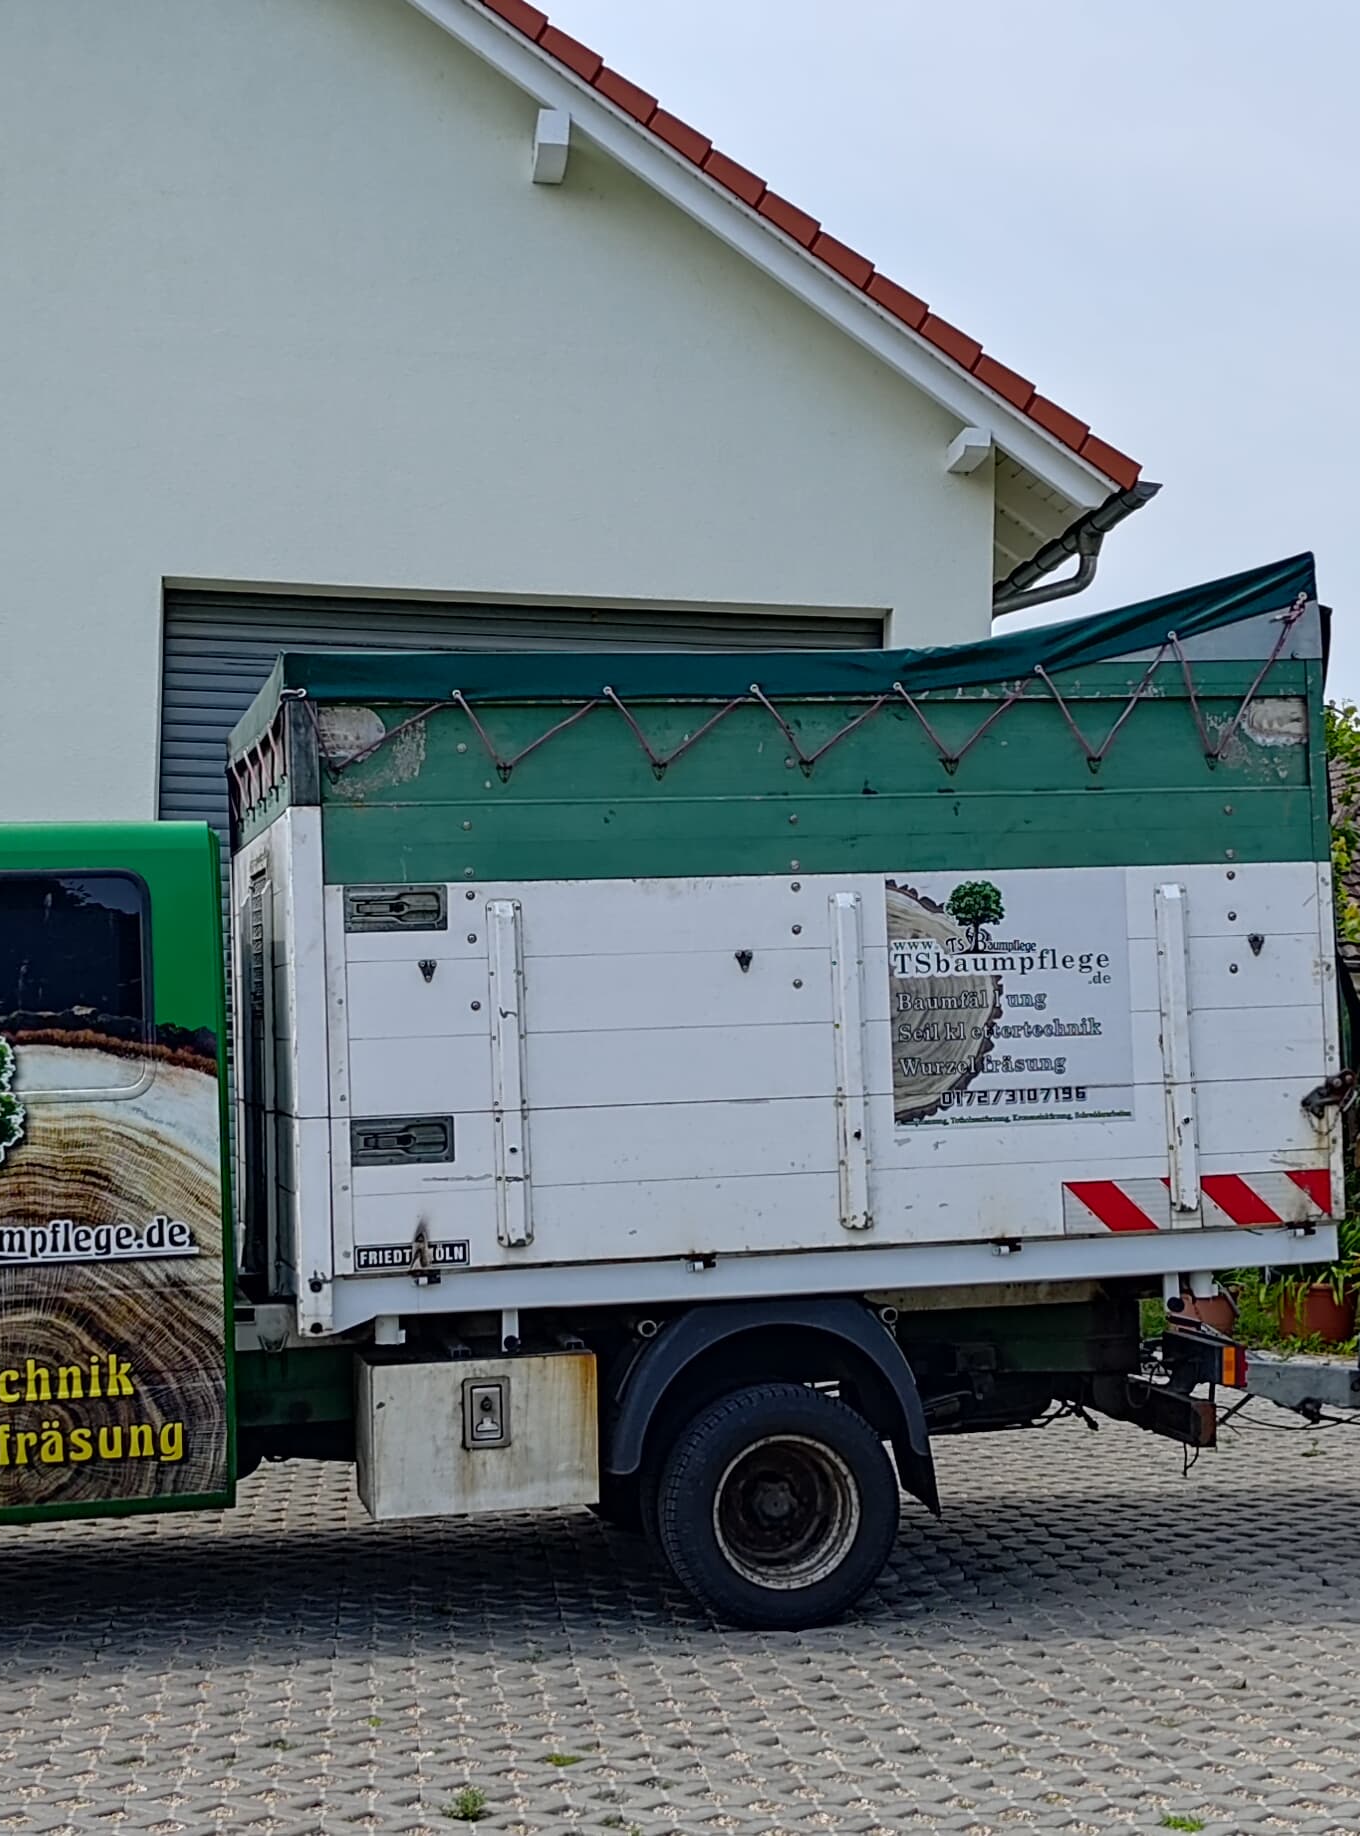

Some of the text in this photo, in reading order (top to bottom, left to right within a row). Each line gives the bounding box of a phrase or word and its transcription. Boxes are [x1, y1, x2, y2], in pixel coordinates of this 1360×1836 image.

[894, 949, 1110, 975] TSbaumpflege
[1087, 971, 1113, 985] .de
[940, 1086, 1087, 1108] 0172/3107196
